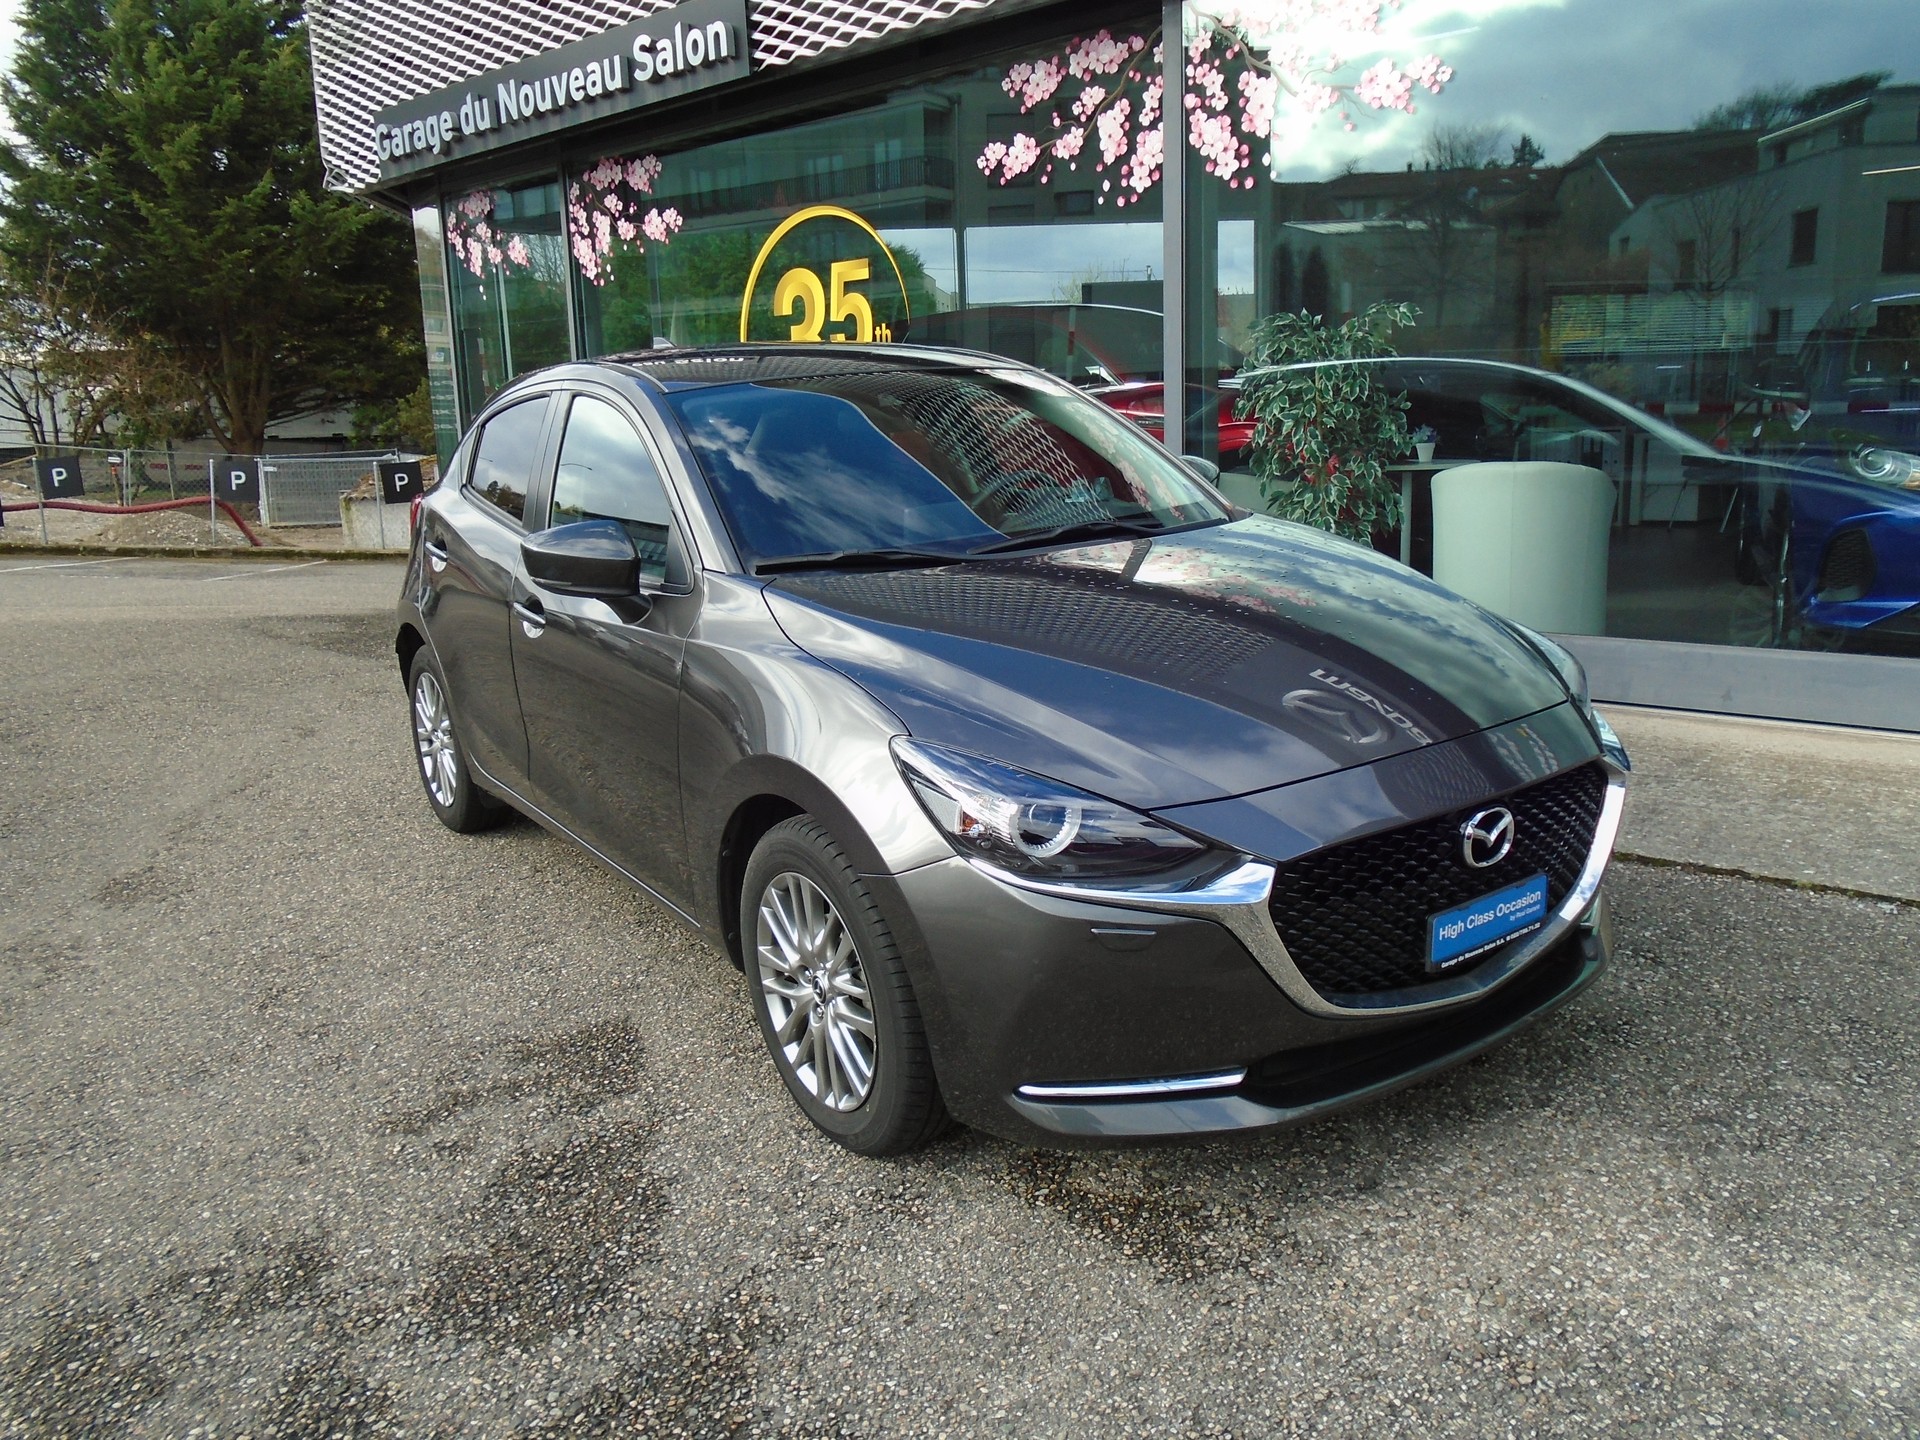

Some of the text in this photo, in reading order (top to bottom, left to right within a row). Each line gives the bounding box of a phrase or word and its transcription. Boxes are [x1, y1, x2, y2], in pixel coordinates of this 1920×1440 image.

[374, 20, 729, 162] Garage du Nouveau Salon
[51, 467, 67, 487] P
[230, 471, 247, 491] P
[394, 473, 409, 492] P
[1439, 920, 1465, 940] High
[1466, 910, 1495, 929] Class
[1496, 891, 1541, 917] Occasion
